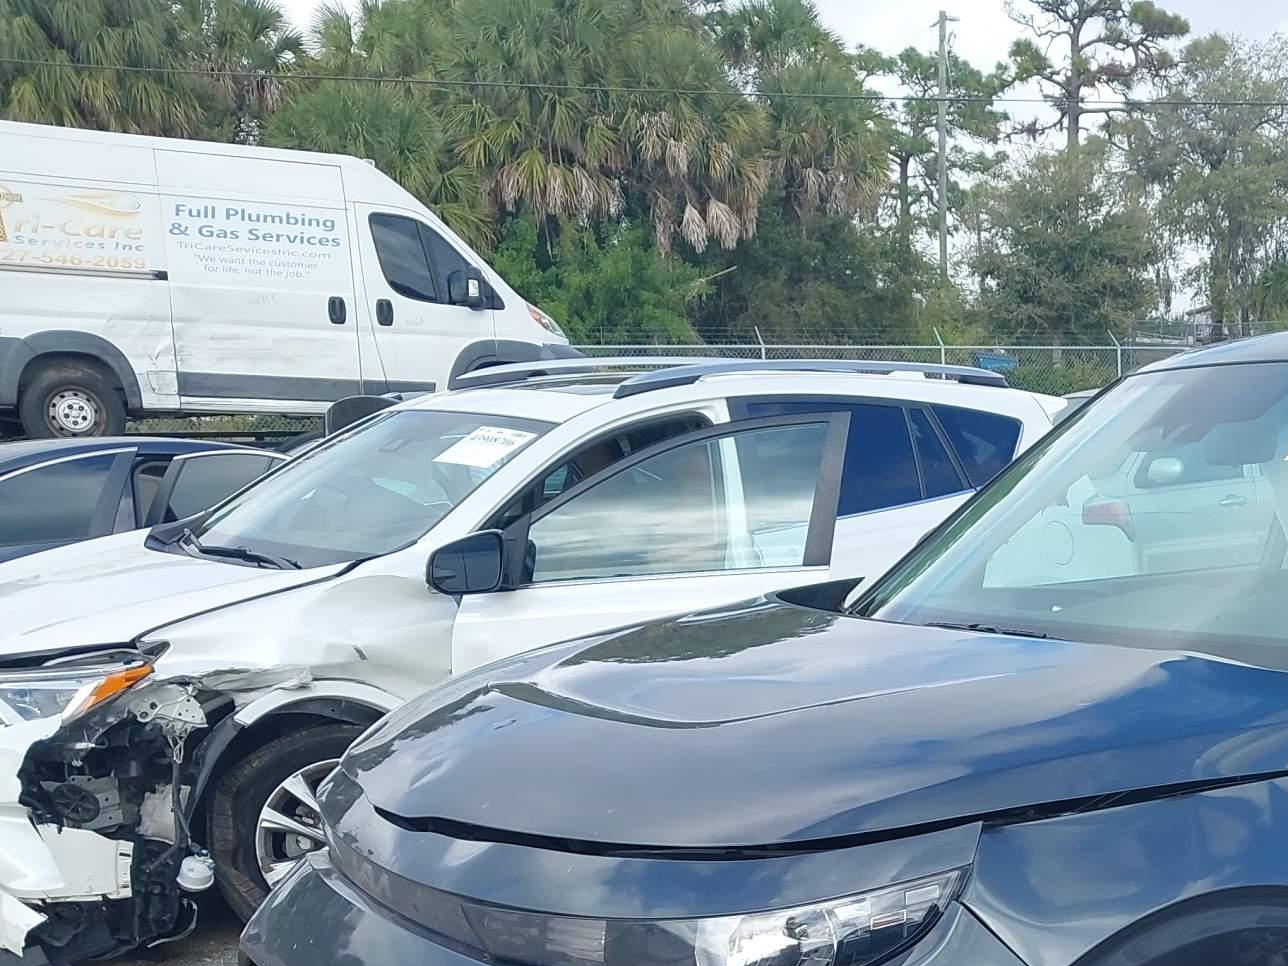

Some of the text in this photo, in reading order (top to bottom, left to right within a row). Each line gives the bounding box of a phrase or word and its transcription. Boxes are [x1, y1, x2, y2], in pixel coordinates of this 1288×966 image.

[175, 204, 336, 232] Full Plumbing
[13, 235, 145, 252] Services Inc
[169, 222, 341, 247] & Gas Services
